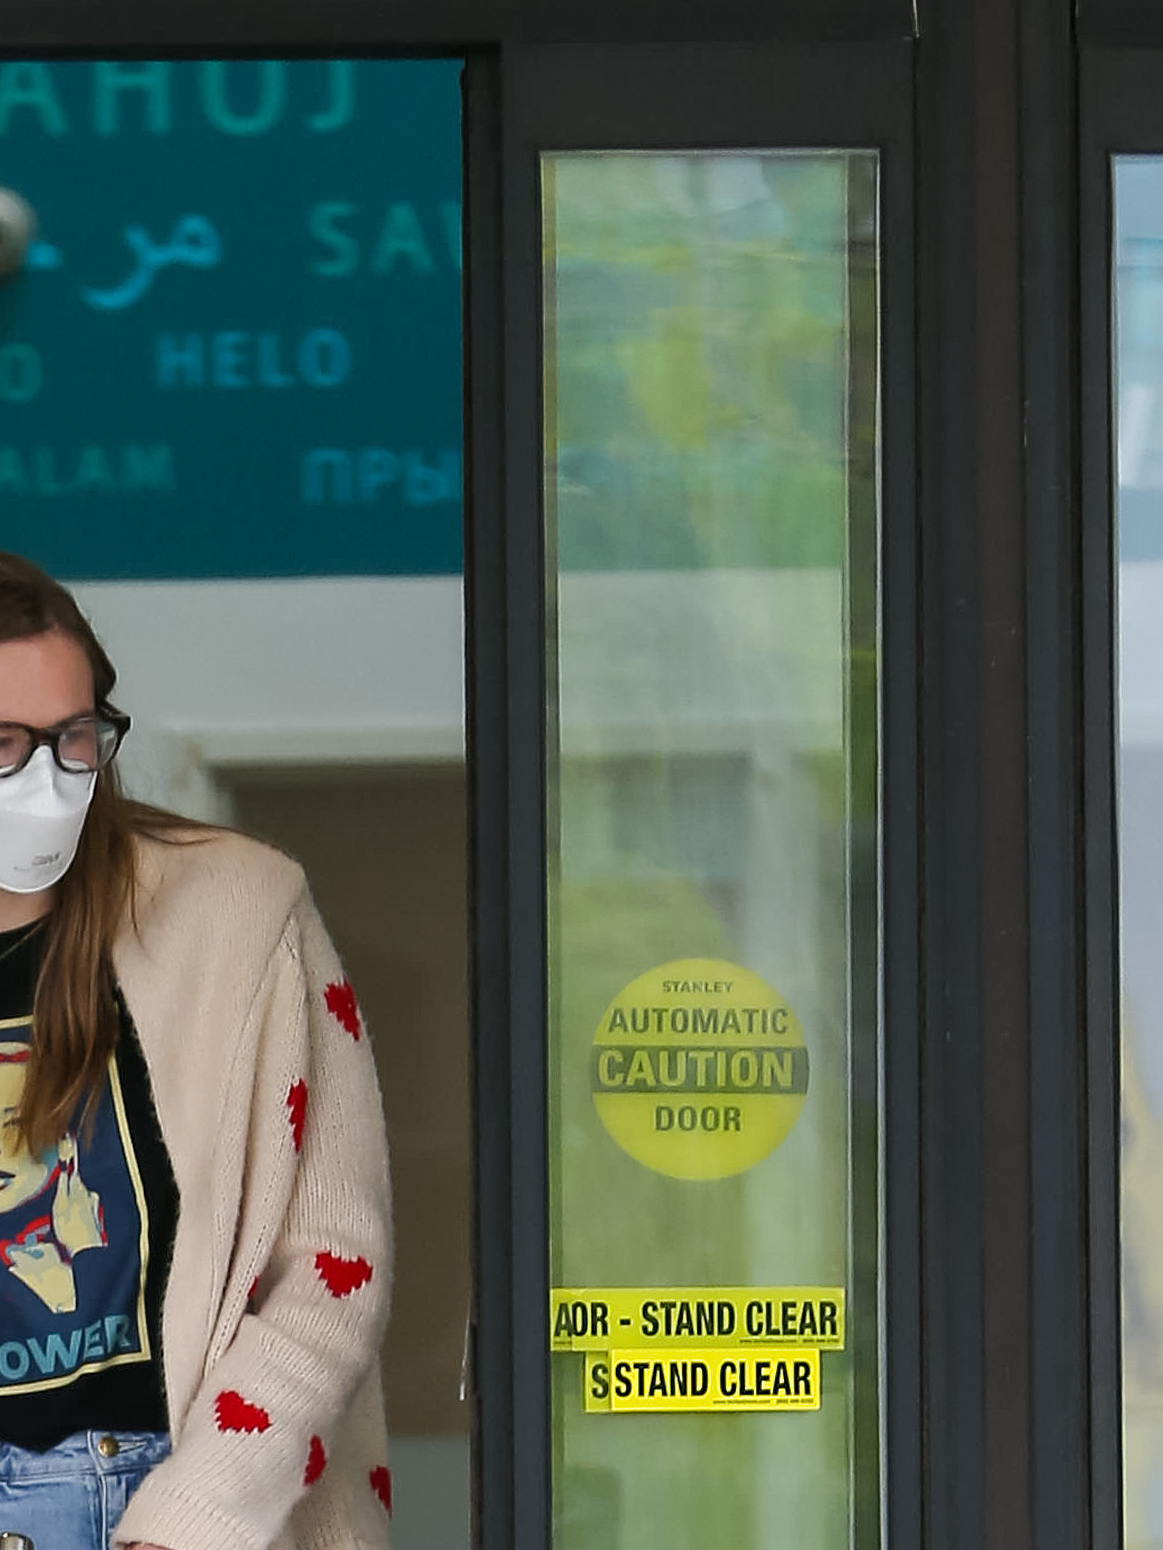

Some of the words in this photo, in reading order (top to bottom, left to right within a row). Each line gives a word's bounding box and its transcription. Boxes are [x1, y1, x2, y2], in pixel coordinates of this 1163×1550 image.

[154, 330, 352, 390] HELO
[662, 980, 733, 994] STANLEY
[607, 1007, 789, 1035] AUTOMATIC
[598, 1048, 794, 1088] CAUTION
[654, 1105, 742, 1132] DOOR
[641, 1301, 735, 1336] STAND
[746, 1301, 837, 1336] CLEAR
[719, 1361, 811, 1397] CLEAR
